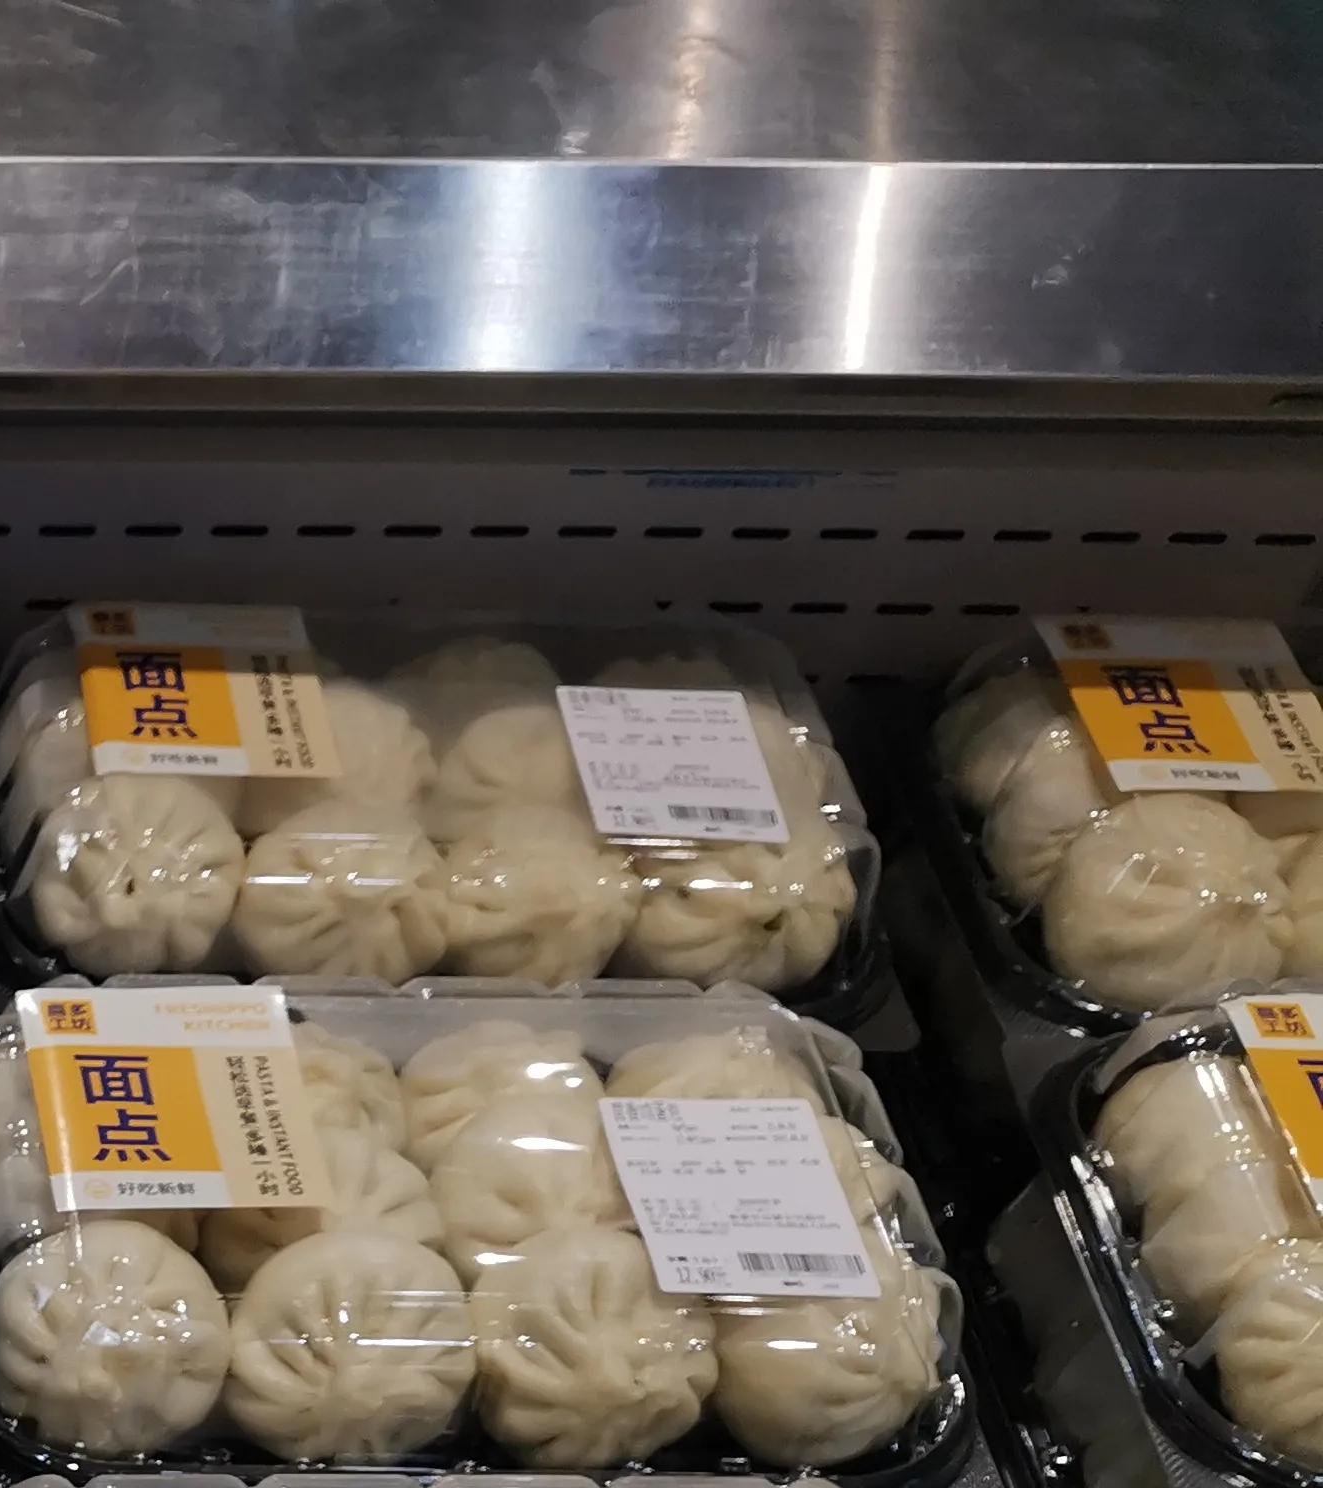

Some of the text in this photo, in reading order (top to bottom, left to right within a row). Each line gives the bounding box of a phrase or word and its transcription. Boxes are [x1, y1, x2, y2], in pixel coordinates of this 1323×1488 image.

[115, 652, 197, 738] 面点
[1101, 665, 1211, 755] 面点
[74, 1054, 171, 1161] 面点
